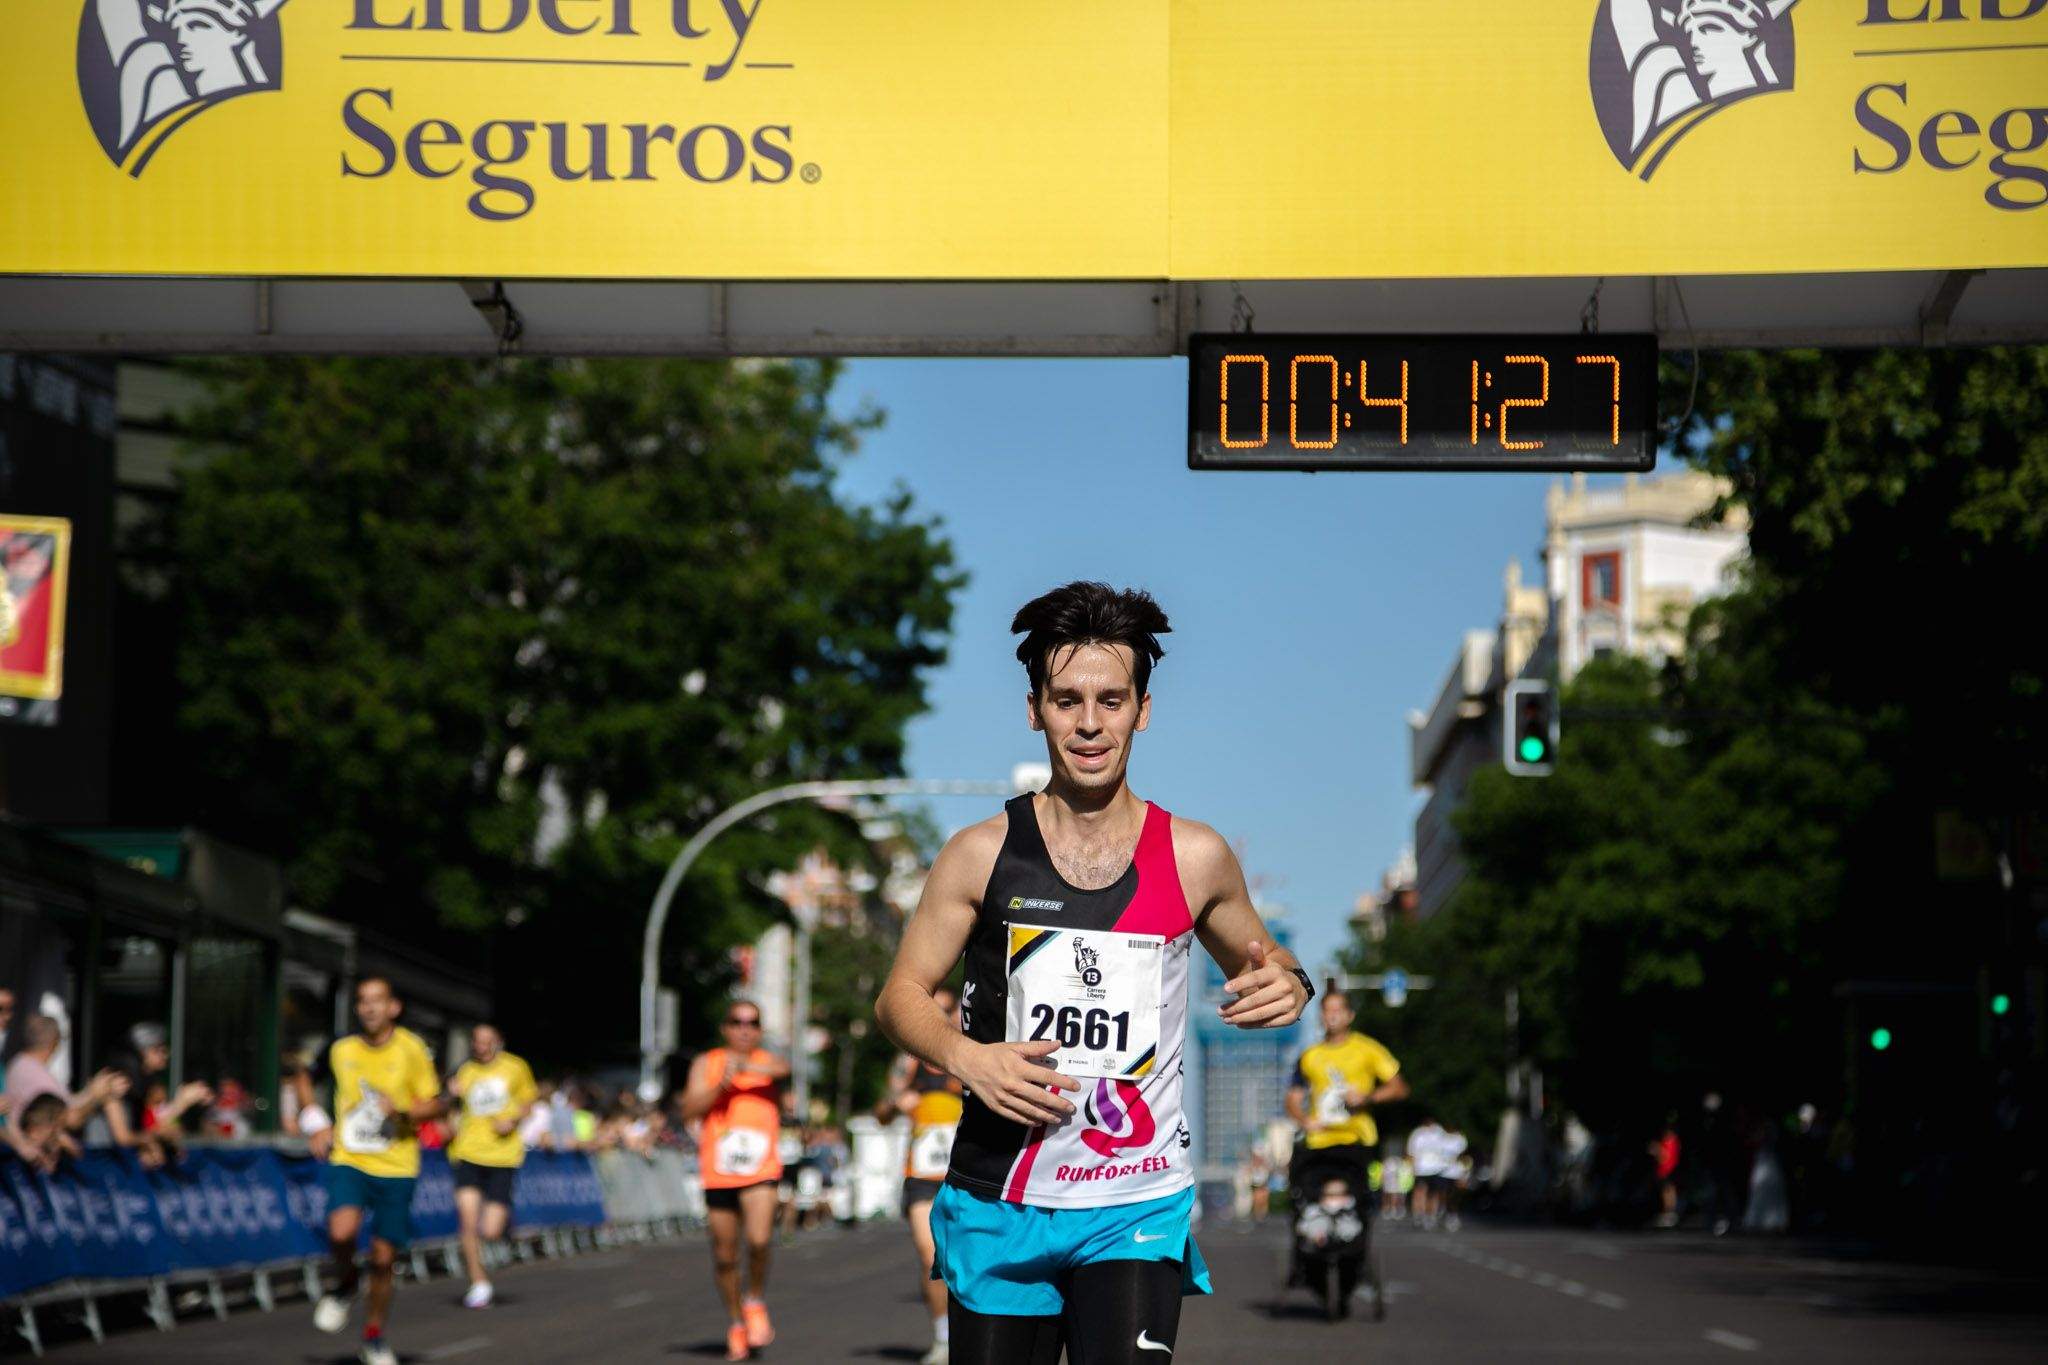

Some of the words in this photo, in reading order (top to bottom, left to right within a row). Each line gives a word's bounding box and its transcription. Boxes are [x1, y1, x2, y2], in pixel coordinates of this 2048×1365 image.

[341, 87, 794, 222] Seguros
[1024, 899, 1062, 910] INVERSE
[1085, 971, 1098, 982] 13
[1086, 992, 1106, 1000] Liberty
[1029, 1003, 1130, 1052] 2661
